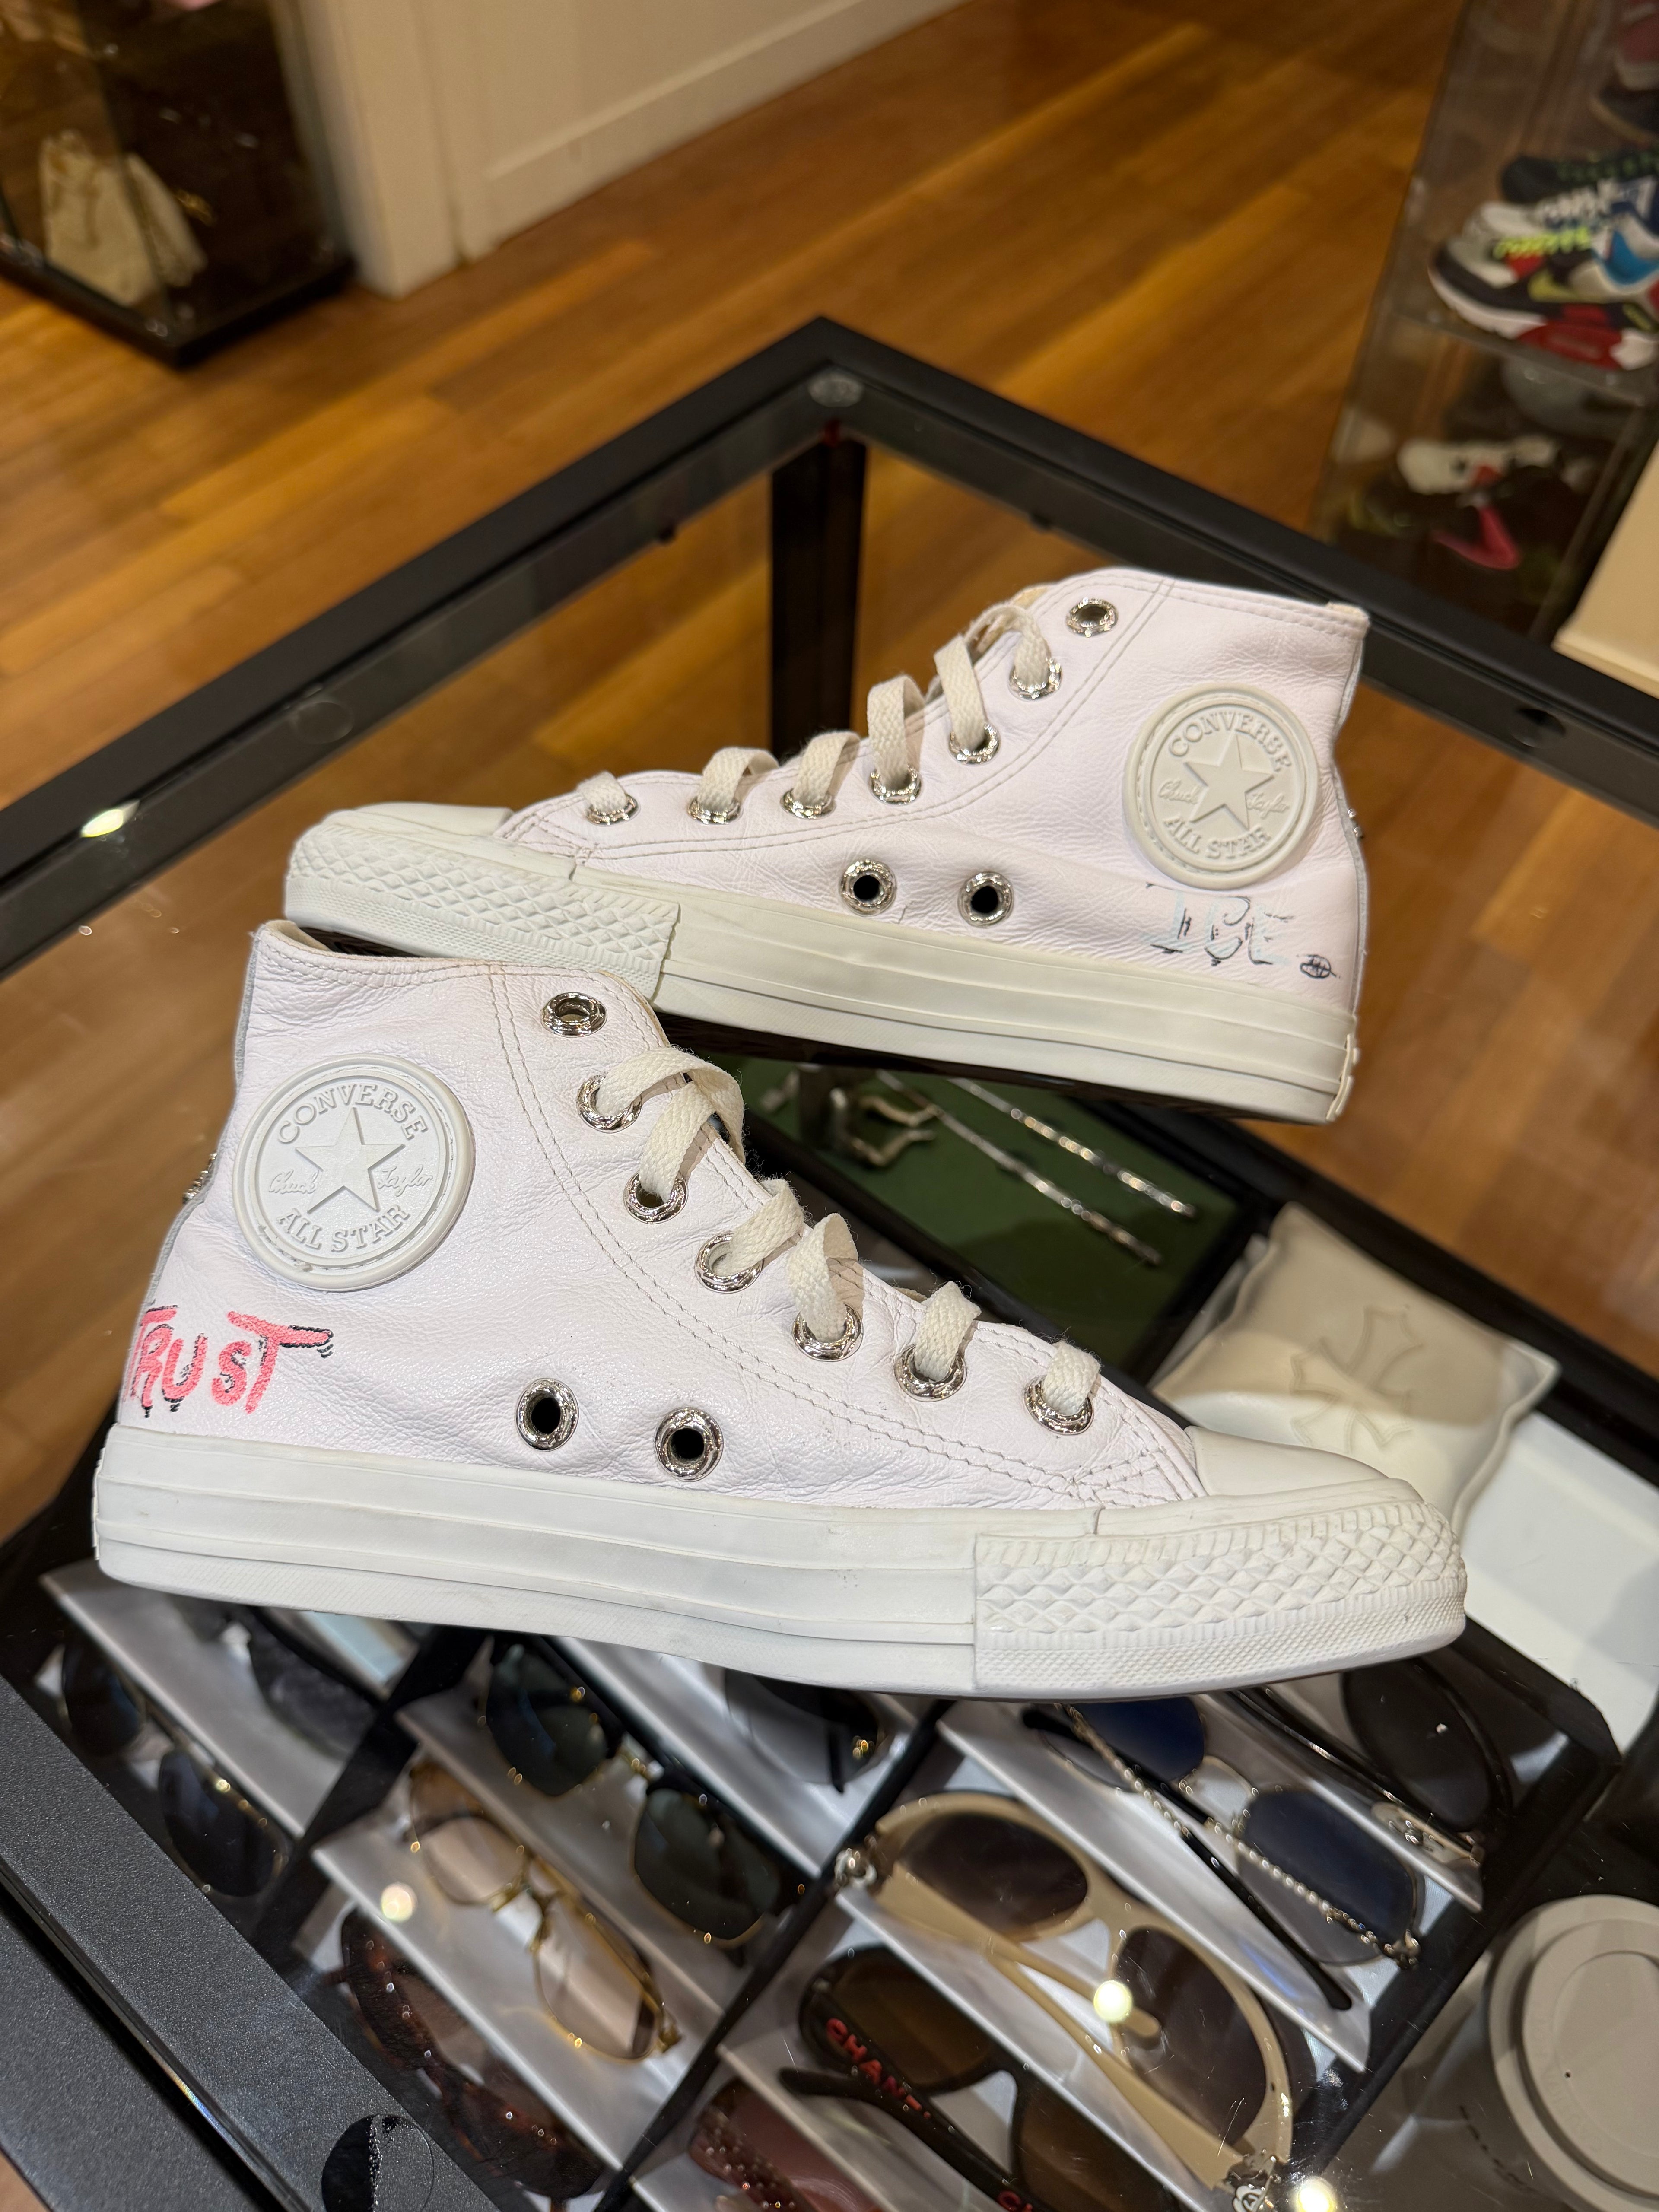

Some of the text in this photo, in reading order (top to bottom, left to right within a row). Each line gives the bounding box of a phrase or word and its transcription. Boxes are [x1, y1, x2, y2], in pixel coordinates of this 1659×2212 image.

[1169, 712, 1292, 772] CONVERSE
[1166, 817, 1271, 860] ALL STAR
[277, 1083, 429, 1145] CONVERSE
[268, 1165, 433, 1197] Chuck Taylor
[277, 1204, 411, 1253] ALL STAR
[123, 1304, 334, 1418] TRUST
[826, 2018, 931, 2118] CHAN
